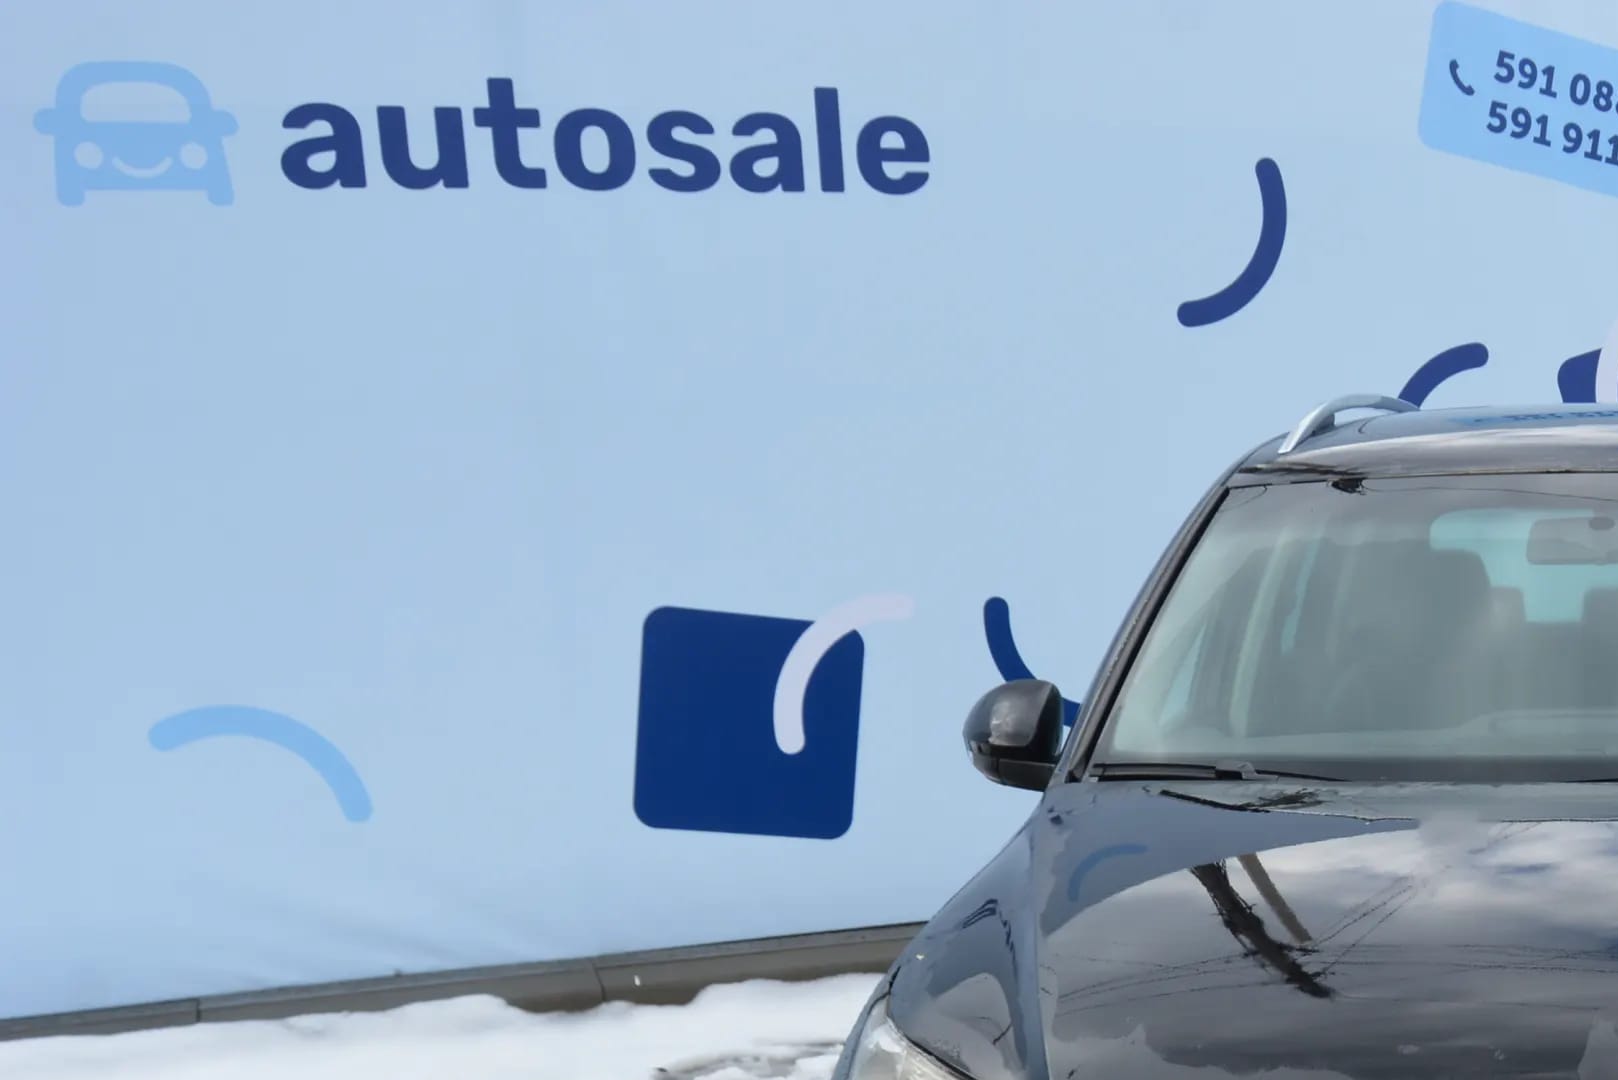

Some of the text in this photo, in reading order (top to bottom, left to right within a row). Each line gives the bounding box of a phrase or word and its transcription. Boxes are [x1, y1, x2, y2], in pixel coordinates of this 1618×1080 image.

[1493, 50, 1558, 99] 591
[280, 77, 931, 195] autosale
[1486, 100, 1552, 147] 591
